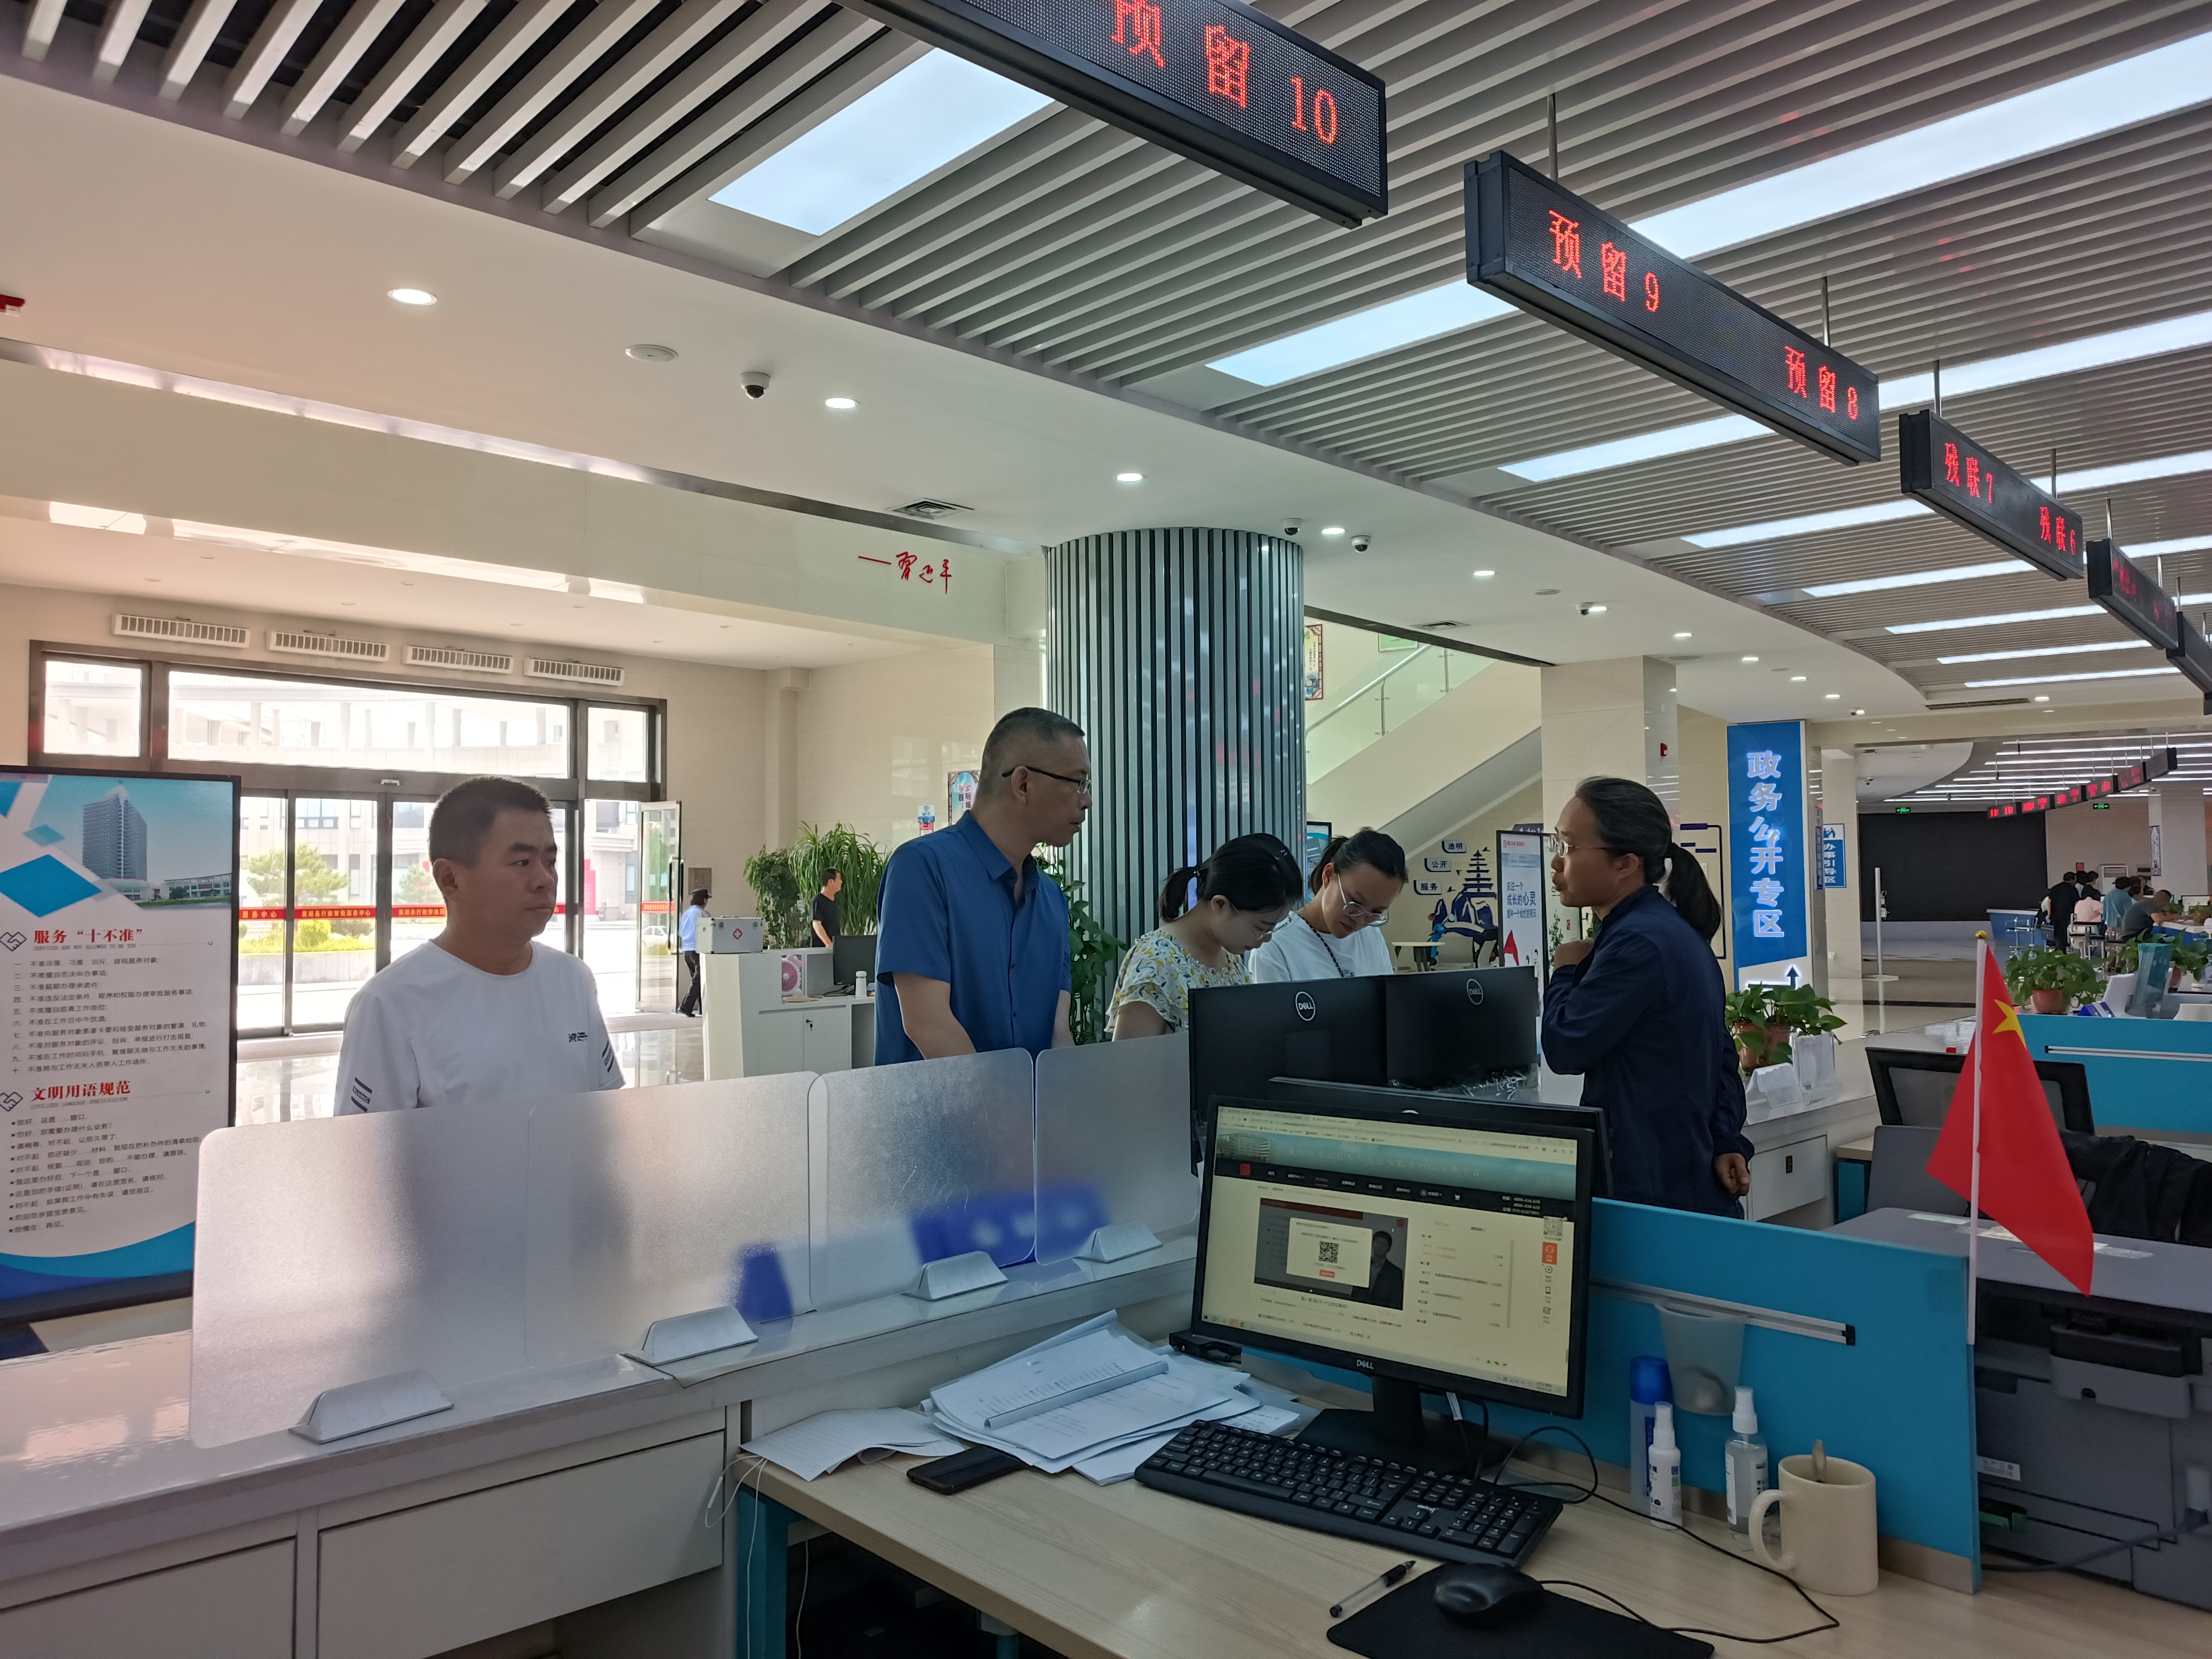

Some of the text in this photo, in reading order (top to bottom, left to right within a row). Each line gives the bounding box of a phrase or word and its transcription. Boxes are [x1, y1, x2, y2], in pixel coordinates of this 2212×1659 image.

[1549, 210, 1660, 312] 预留9
[1784, 346, 1859, 420] 预留8
[1746, 750, 1785, 938] 政务公开专区
[1431, 860, 1448, 869] 公开
[1298, 1002, 1314, 1010] DELL
[30, 1080, 131, 1102] 文明用语规范
[1356, 1359, 1374, 1370] DELL
